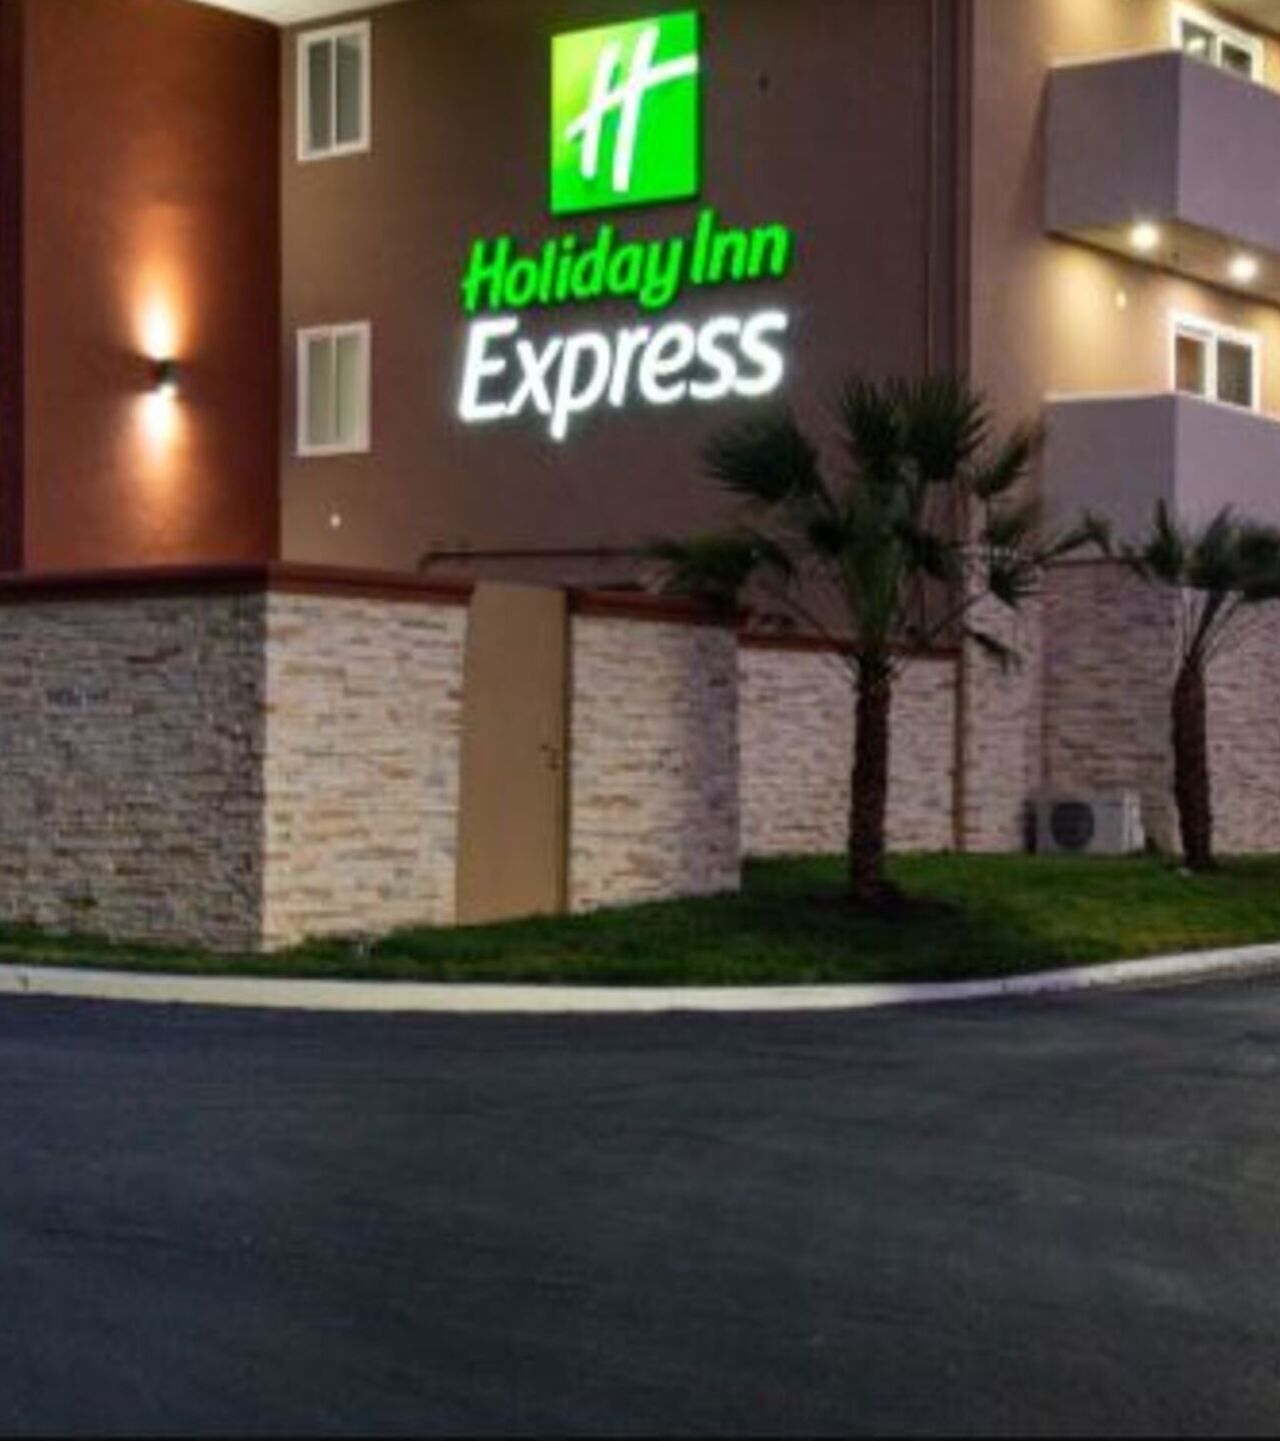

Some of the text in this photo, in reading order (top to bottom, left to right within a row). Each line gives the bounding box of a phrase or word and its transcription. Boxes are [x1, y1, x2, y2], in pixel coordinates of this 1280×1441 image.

[566, 23, 699, 194] H
[460, 208, 791, 310] Holiday Inn
[457, 309, 789, 442] Express
